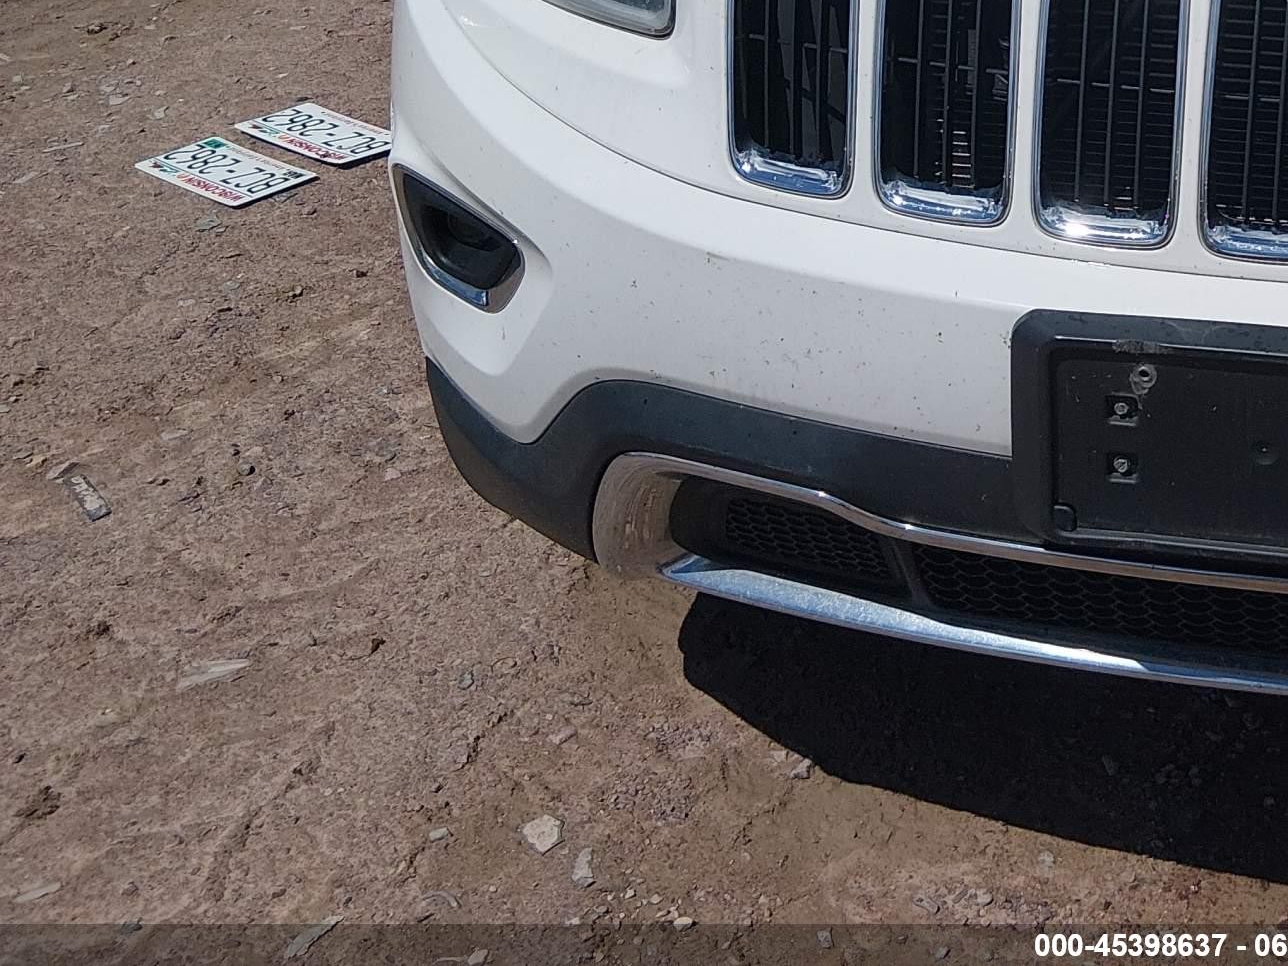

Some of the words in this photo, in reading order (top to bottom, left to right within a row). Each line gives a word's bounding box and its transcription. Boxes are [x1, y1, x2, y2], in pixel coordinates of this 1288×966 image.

[262, 108, 392, 155] BCZ-2862
[285, 135, 348, 160] WISCONSIN
[163, 143, 290, 194] BCZ-2862
[182, 175, 243, 202] WISCONSIN
